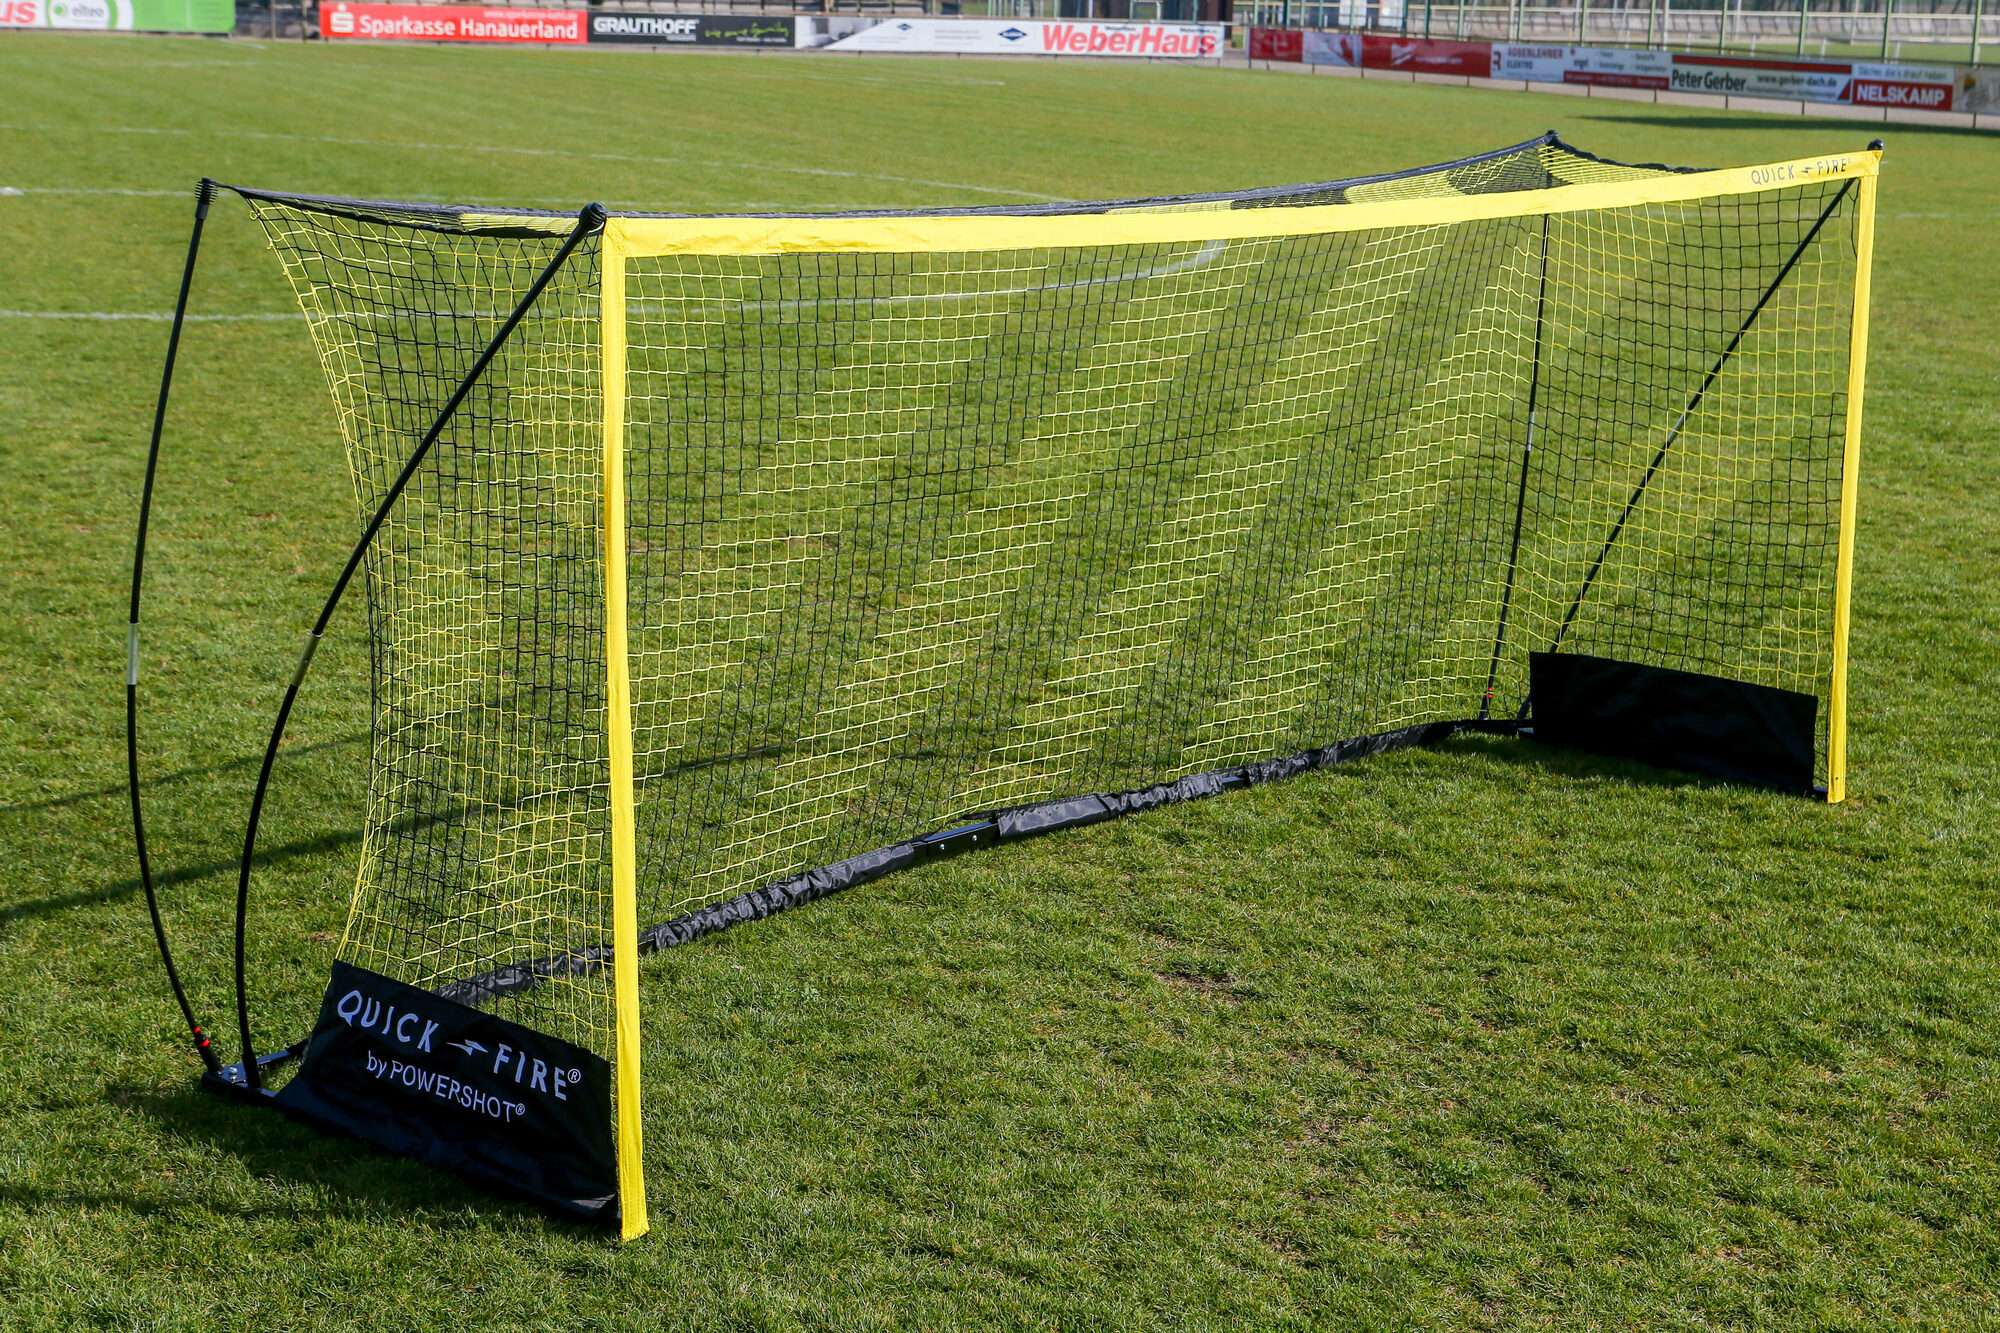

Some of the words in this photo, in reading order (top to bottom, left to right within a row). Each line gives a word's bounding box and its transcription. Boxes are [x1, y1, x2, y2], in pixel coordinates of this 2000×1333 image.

[359, 15, 456, 37] Sparkasse
[460, 17, 578, 39] Hanauerland
[593, 17, 697, 35] GRAUTHOFF
[1042, 24, 1217, 55] WeberHaus
[1671, 69, 1703, 88] Peter
[1704, 71, 1747, 92] Gerber
[1856, 83, 1945, 105] NELSKAMP
[1751, 165, 1795, 185] QUICK
[337, 989, 440, 1053] QUICK
[366, 1050, 388, 1079] by
